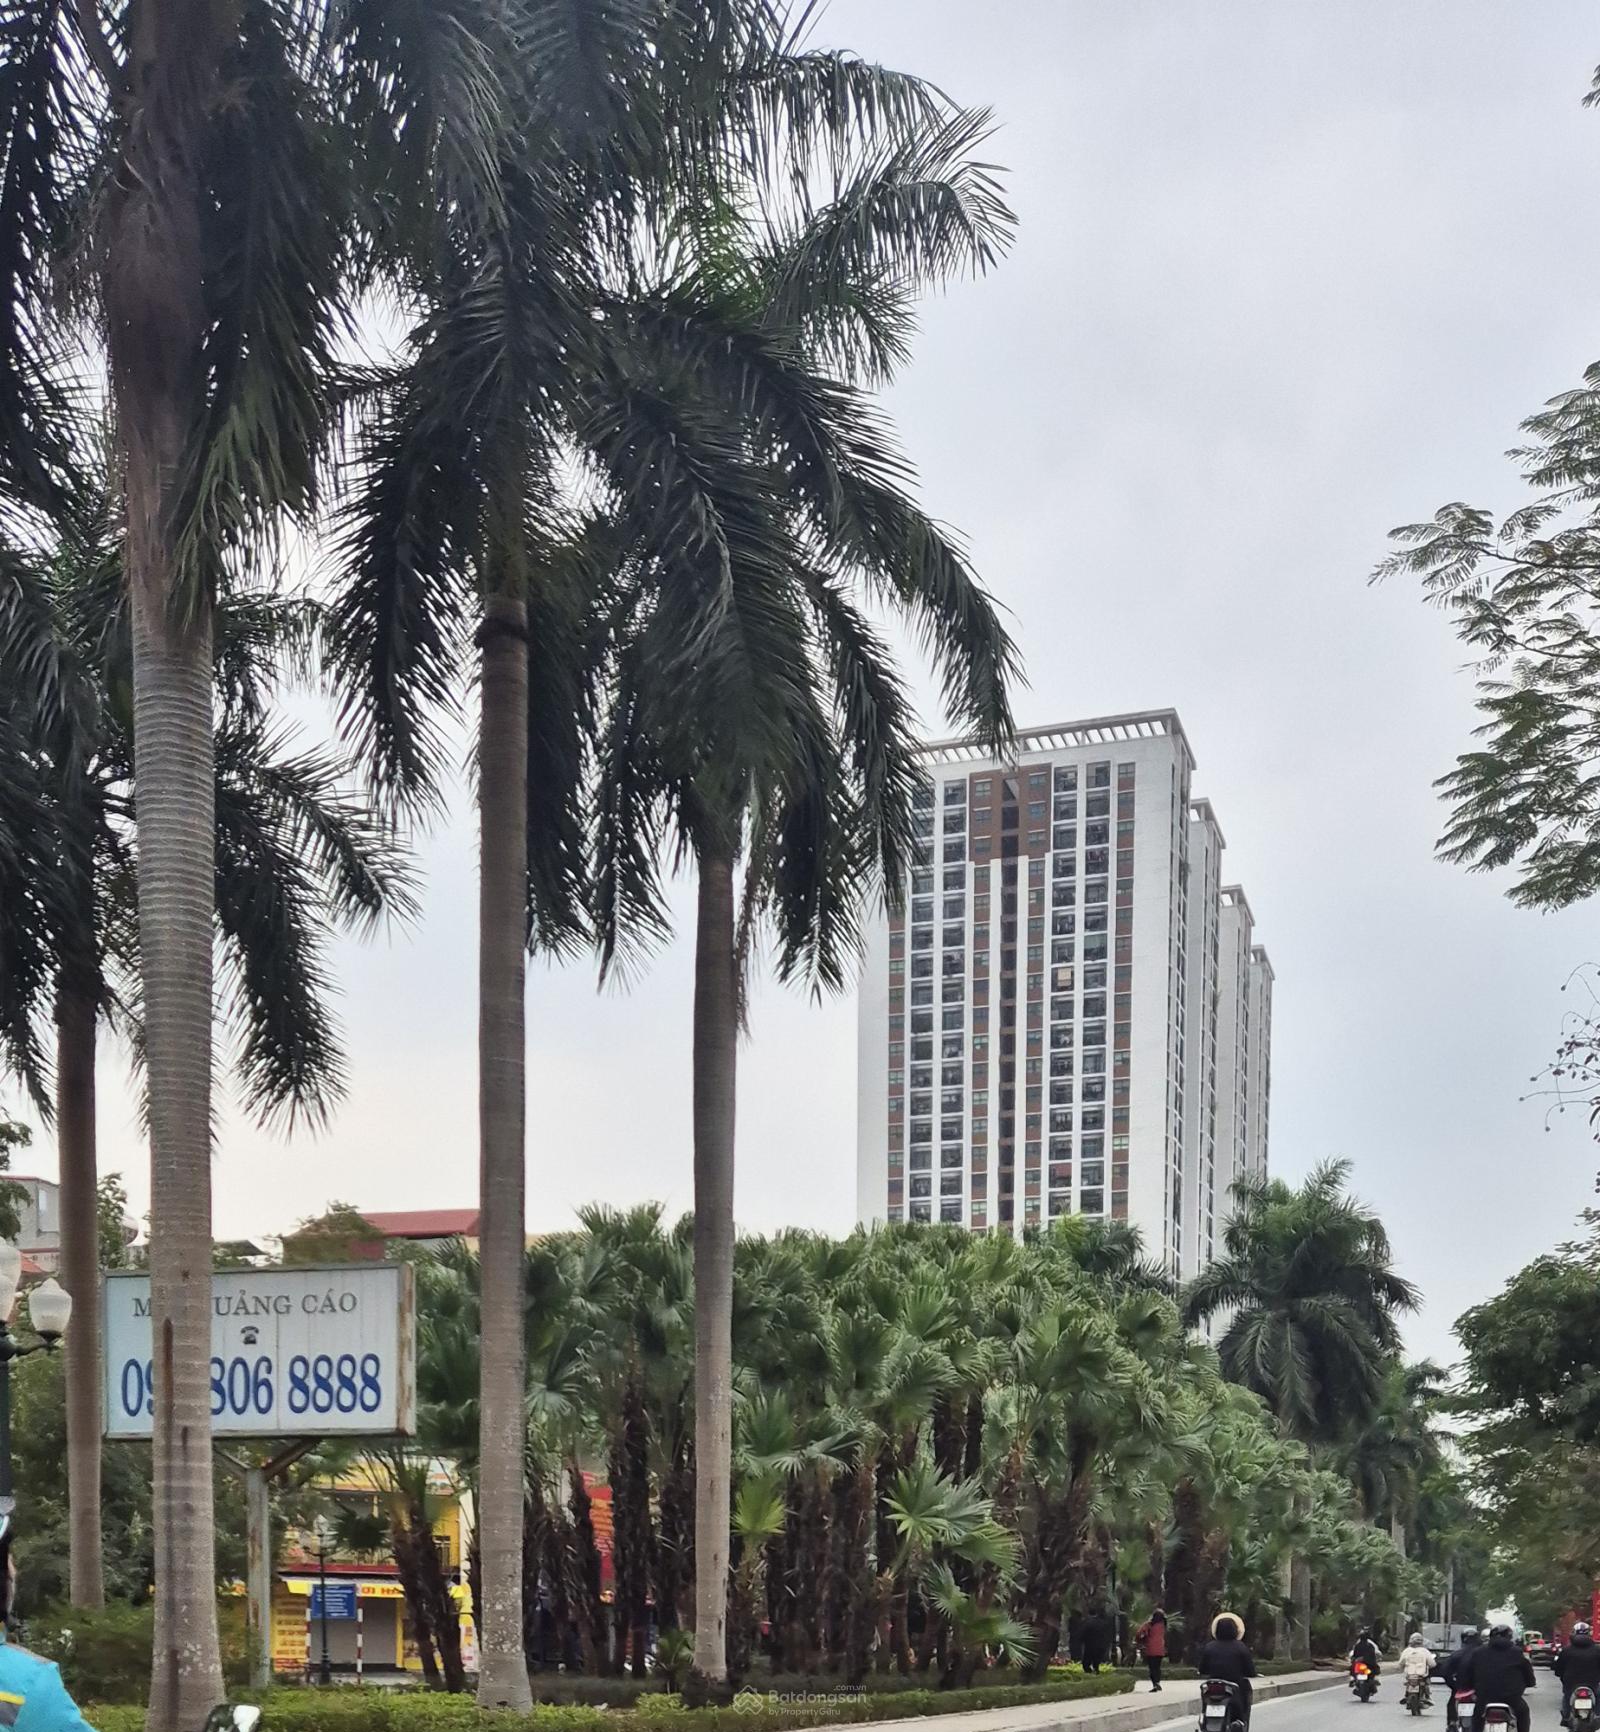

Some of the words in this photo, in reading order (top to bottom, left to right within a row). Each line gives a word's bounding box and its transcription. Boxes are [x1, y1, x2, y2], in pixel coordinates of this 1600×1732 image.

[213, 1289, 291, 1316] UẢNG
[301, 1288, 358, 1315] CÁO
[211, 1355, 274, 1416] 806
[288, 1353, 382, 1413] 8888
